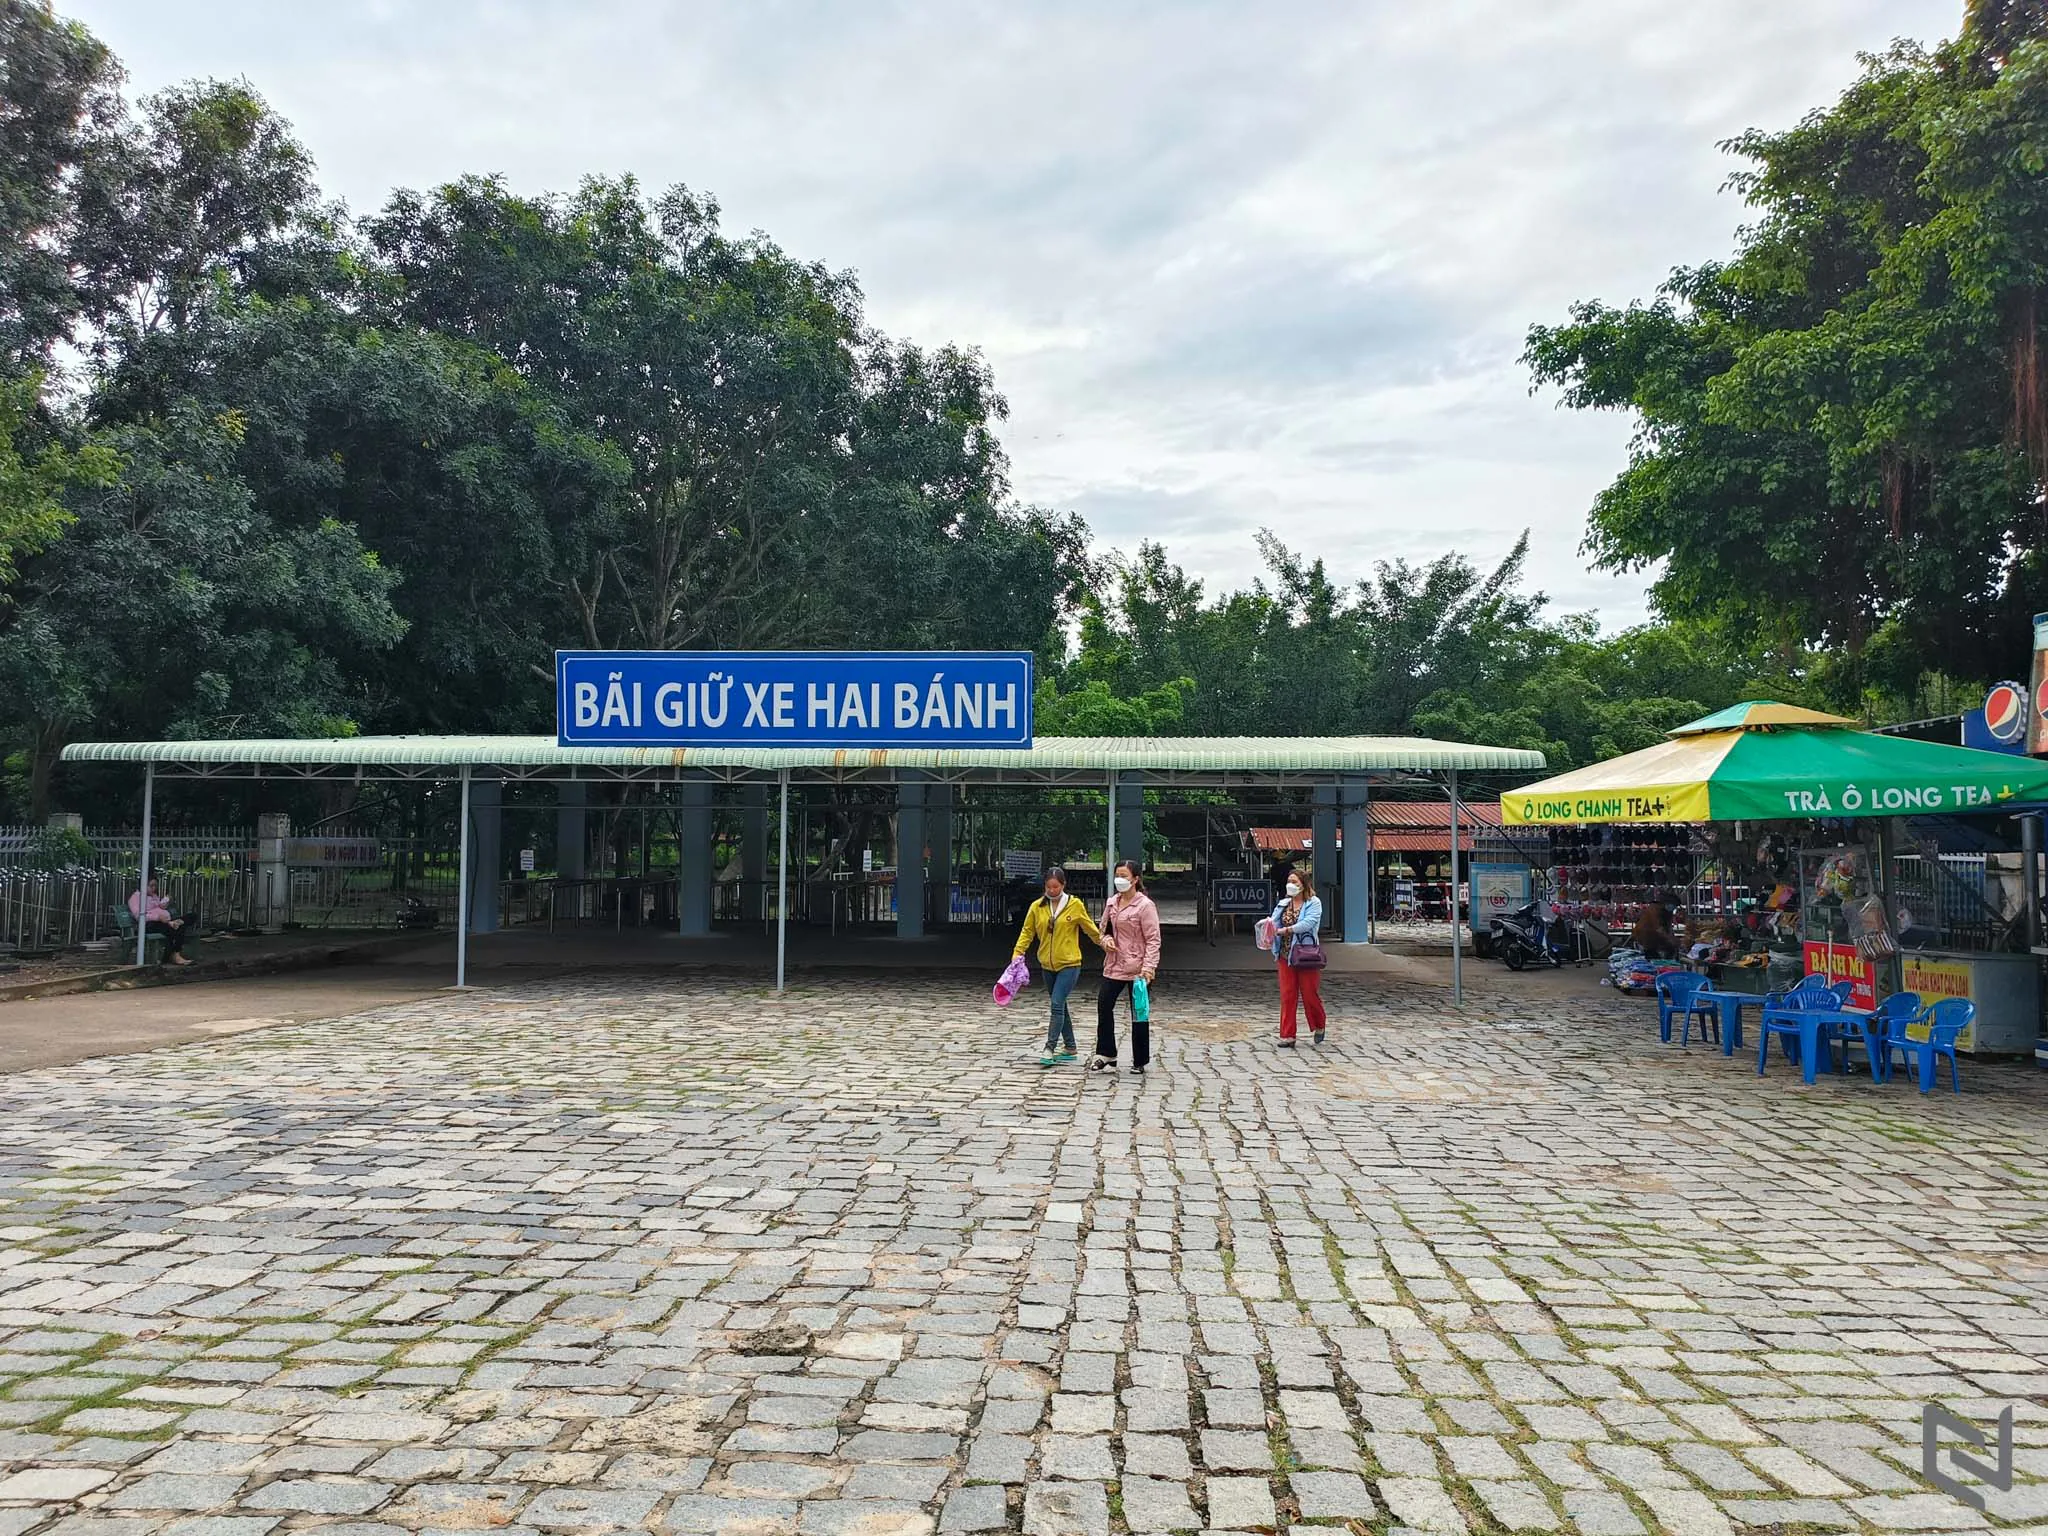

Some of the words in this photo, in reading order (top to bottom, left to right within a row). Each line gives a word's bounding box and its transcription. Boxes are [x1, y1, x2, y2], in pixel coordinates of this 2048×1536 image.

[574, 671, 642, 729] BÃI
[654, 671, 735, 729] GIỮ
[742, 682, 796, 729] XE
[807, 682, 880, 729] HAI
[894, 672, 1017, 730] BÁNH
[1523, 798, 1534, 820] Ô
[1537, 801, 1572, 819] LONG
[1576, 798, 1622, 818] CHANH
[1784, 784, 1832, 812] TRÀ
[1841, 784, 1863, 810] Ô
[1871, 787, 1943, 809] LONG
[1240, 885, 1265, 901] VÀO
